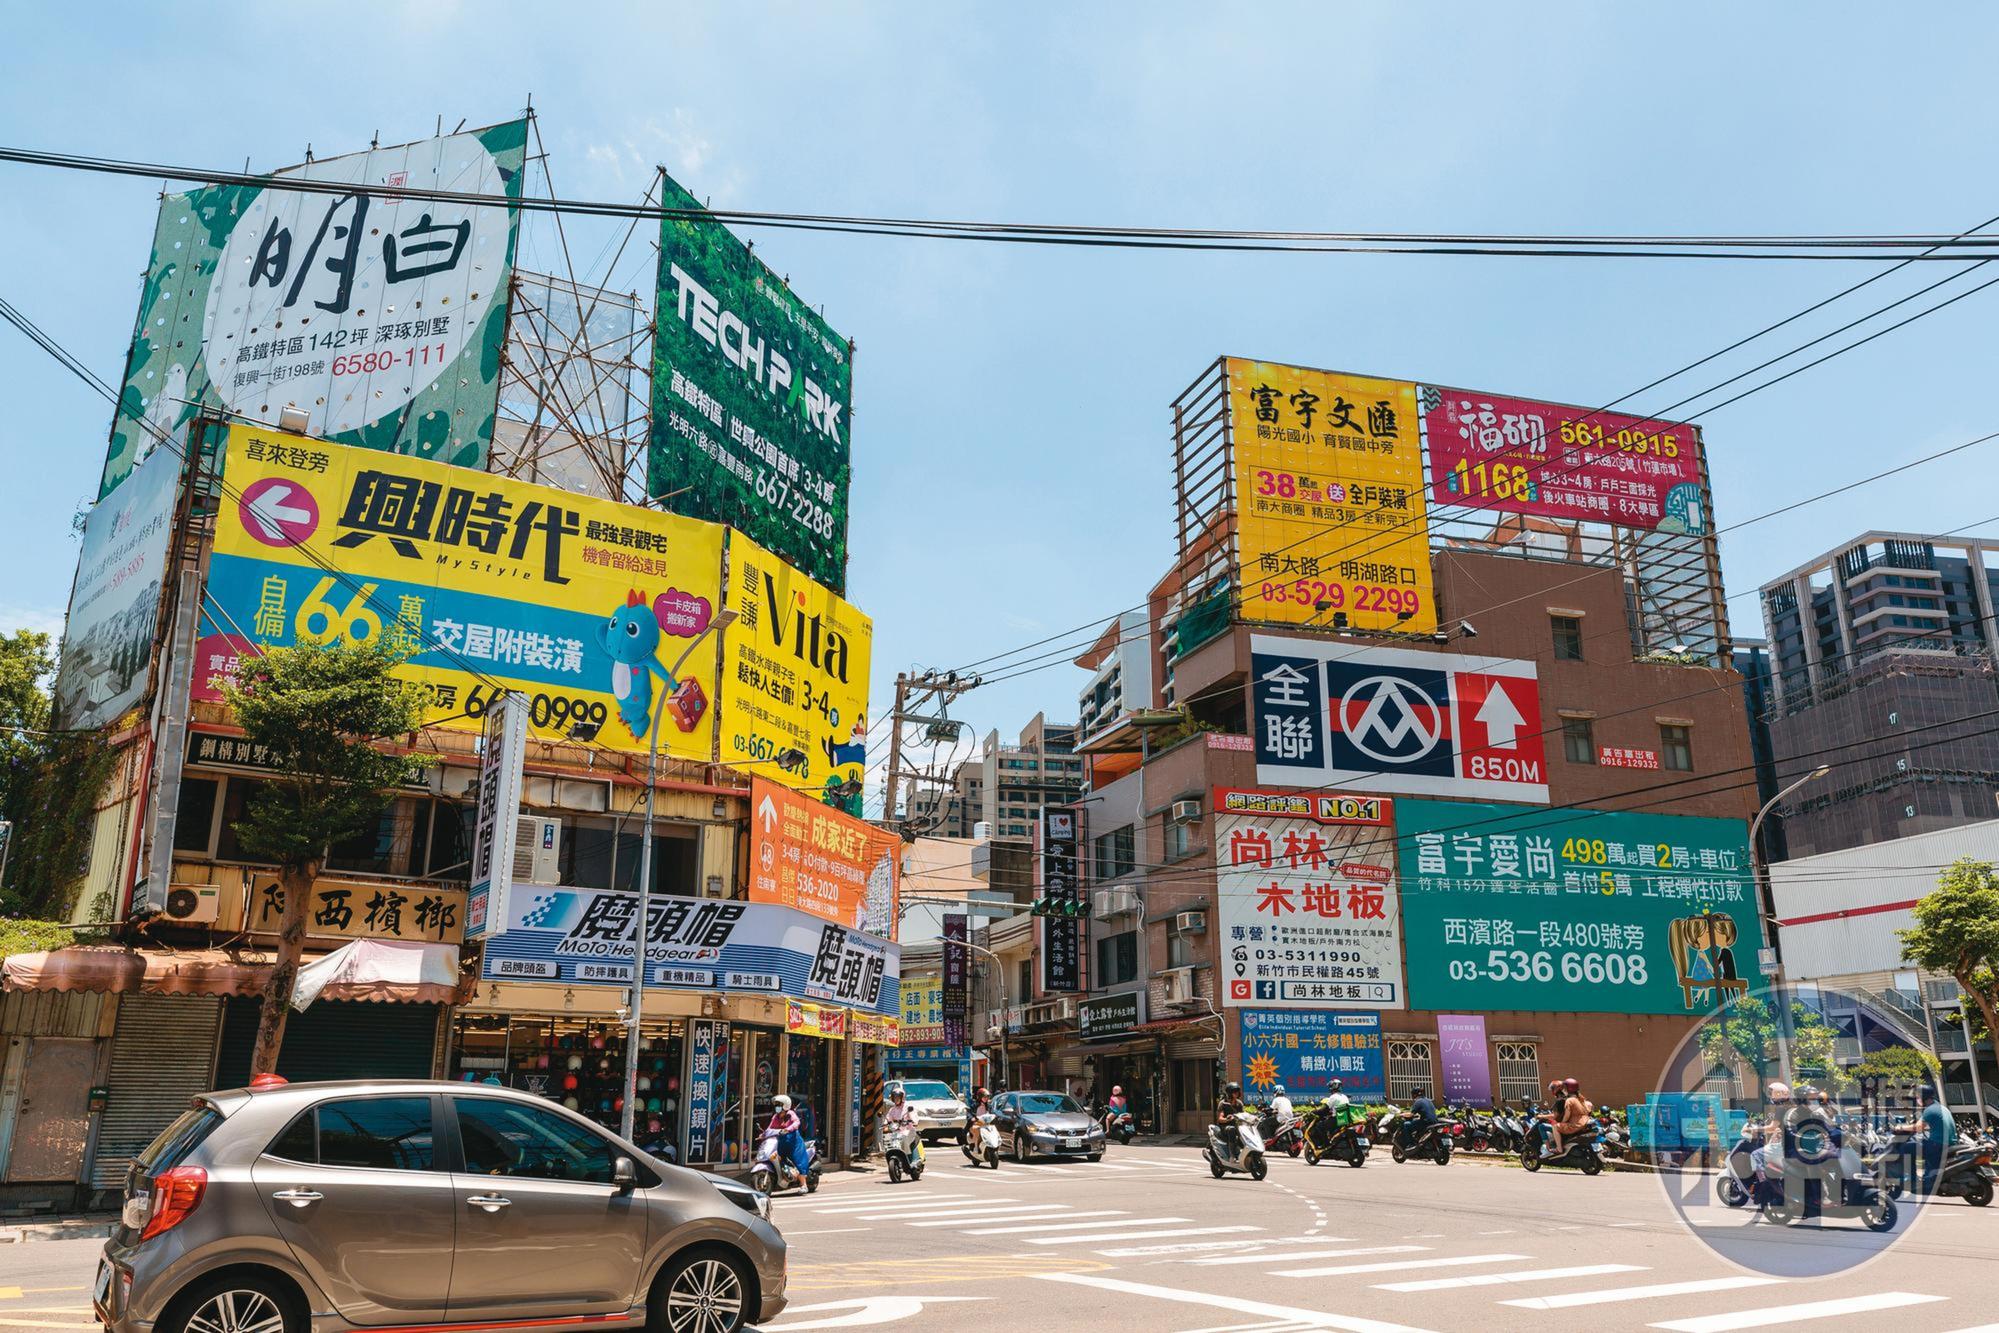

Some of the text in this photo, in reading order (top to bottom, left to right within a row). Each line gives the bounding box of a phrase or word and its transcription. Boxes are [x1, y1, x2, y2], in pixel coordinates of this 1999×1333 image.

[249, 191, 470, 314] 明白
[233, 344, 446, 387] 復興一街198號 6580-111
[670, 262, 841, 444] TECH PARK
[670, 370, 723, 429] 高鐵特區
[1250, 383, 1398, 439] 富宇文匯
[244, 438, 330, 474] 喜來登旁
[1257, 424, 1394, 455] 陽光國小 育賢國中旁
[1559, 419, 1679, 458] 561-0915
[1257, 470, 1296, 498] 38
[1328, 483, 1346, 503] 送
[1349, 483, 1408, 511] 全戶裝潢
[1455, 457, 1530, 502] 1168
[755, 467, 834, 541] 667-2288
[1256, 501, 1410, 528] 南大商圈 精品3房 全新完工
[1542, 490, 1610, 511] 後火車站商圈
[1619, 498, 1660, 517] 8大學區
[330, 469, 580, 585] 興時代
[585, 520, 668, 554] 最強景觀宅
[582, 545, 668, 578] 機會留給遠見
[1259, 552, 1417, 586] 南大路 明湖路口
[253, 575, 287, 639] 自備
[295, 576, 381, 647] 66
[662, 599, 702, 616] 一卡皮箱
[740, 561, 759, 632] 豐謙
[1261, 580, 1419, 615] 03-529 2299
[666, 612, 698, 629] 搬新家
[763, 571, 849, 685] Vita
[431, 617, 584, 674] 交屋附裝潢
[738, 643, 796, 685] 高鐵水岸親子宅
[737, 661, 795, 707] 鬆快人生價!
[1262, 663, 1313, 760] 全聯
[1889, 712, 1899, 725] 17
[1470, 756, 1540, 783] 850M
[1600, 756, 1659, 769] 0916-129332
[1226, 793, 1379, 820] 網路評鑑 NO.1
[812, 814, 867, 862] 成家近了
[1230, 829, 1329, 871] 尚林
[1415, 829, 1556, 880] 富宇愛尚
[797, 872, 839, 902] 536-2020
[1256, 881, 1386, 921] 木地板
[1562, 870, 1744, 902] 首付5萬 工程彈性付款
[569, 894, 746, 948] 魔頭帽
[1231, 925, 1265, 942] 專營
[1443, 918, 1645, 951] 西濱路一段480號旁
[610, 943, 698, 960] Hedgear
[810, 924, 885, 1004] 魔頭帽
[1255, 949, 1361, 963] 03-5311990
[1449, 950, 1649, 986] 03-536 6608
[500, 961, 775, 988] 品牌頭盔 防摔護具 重機精品 騎士雨具
[1256, 964, 1380, 979] 新竹市民權路45號
[1293, 984, 1362, 998] 尚林地板
[715, 1023, 729, 1039] 手套
[1244, 1032, 1380, 1050] 小六升國一先修體驗班
[1301, 1055, 1365, 1072] 精緻小團班
[689, 1026, 712, 1157] 快速換鏡片
